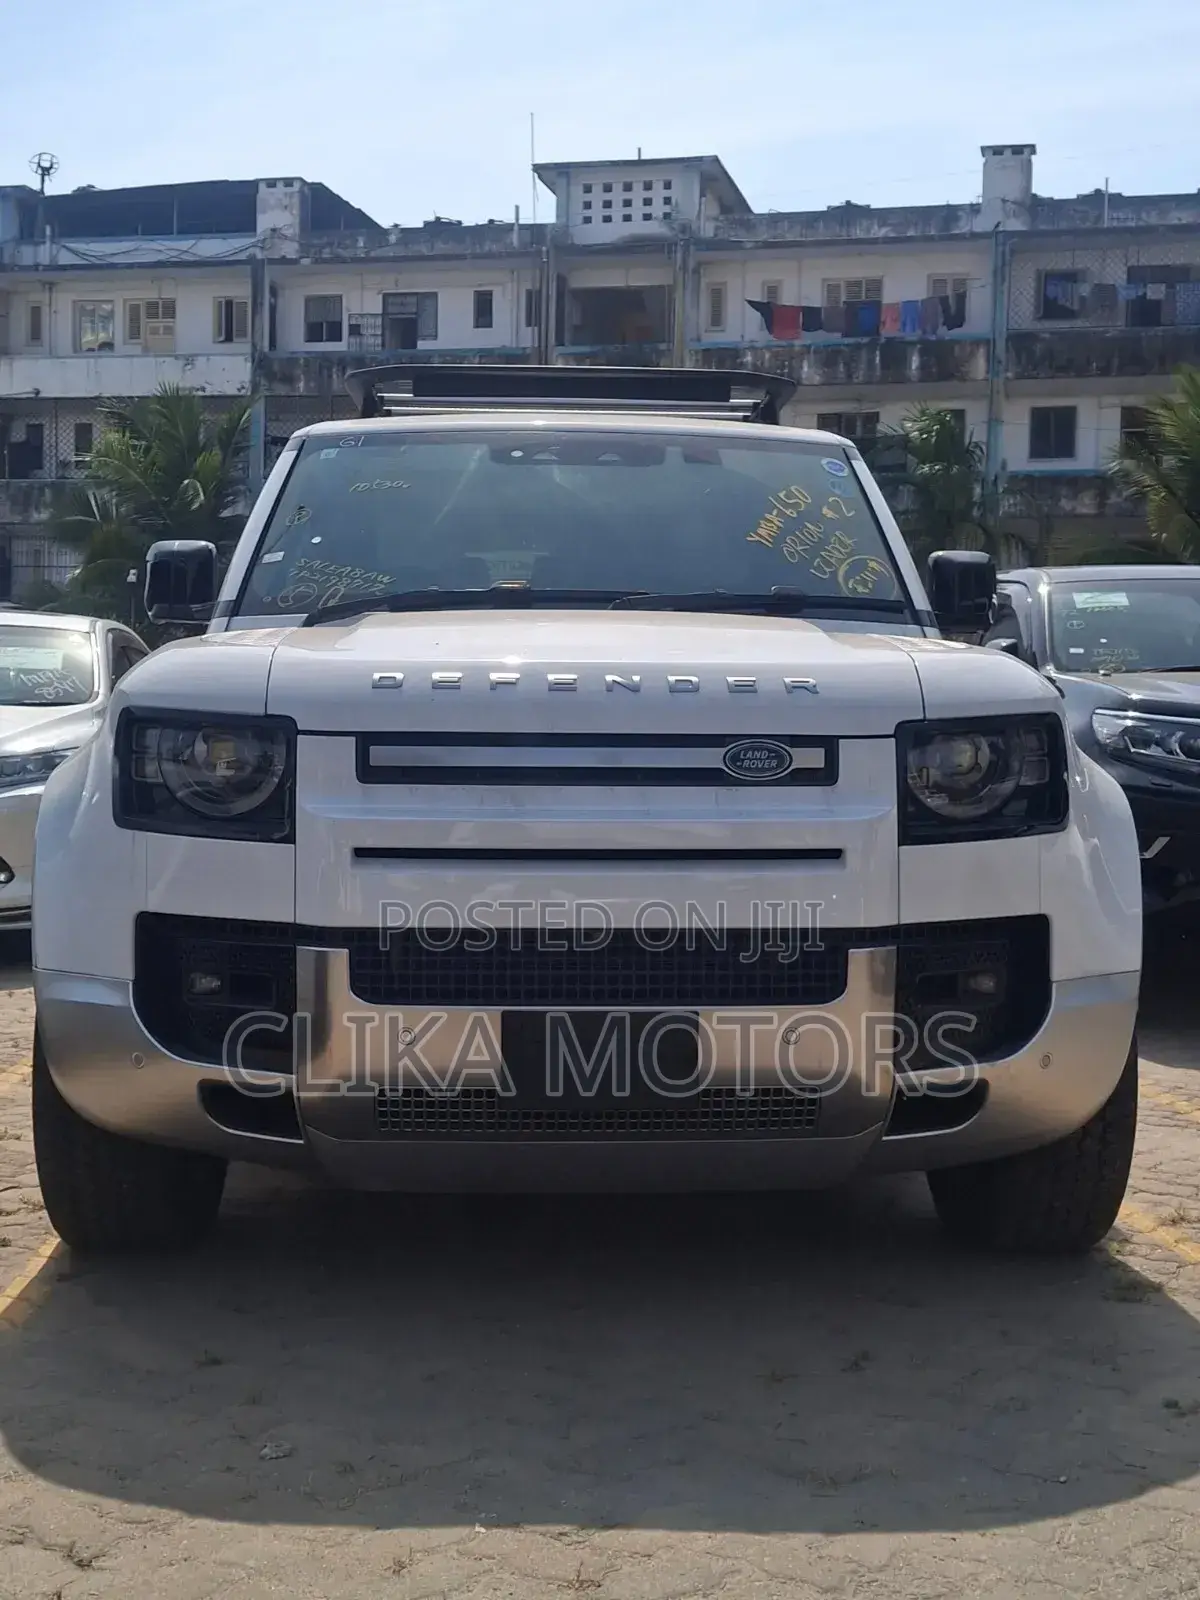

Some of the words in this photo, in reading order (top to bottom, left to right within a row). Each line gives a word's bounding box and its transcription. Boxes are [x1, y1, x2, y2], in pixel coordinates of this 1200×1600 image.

[371, 672, 819, 694] DEFENDER
[740, 750, 769, 759] LAND
[741, 759, 778, 768] ROVER
